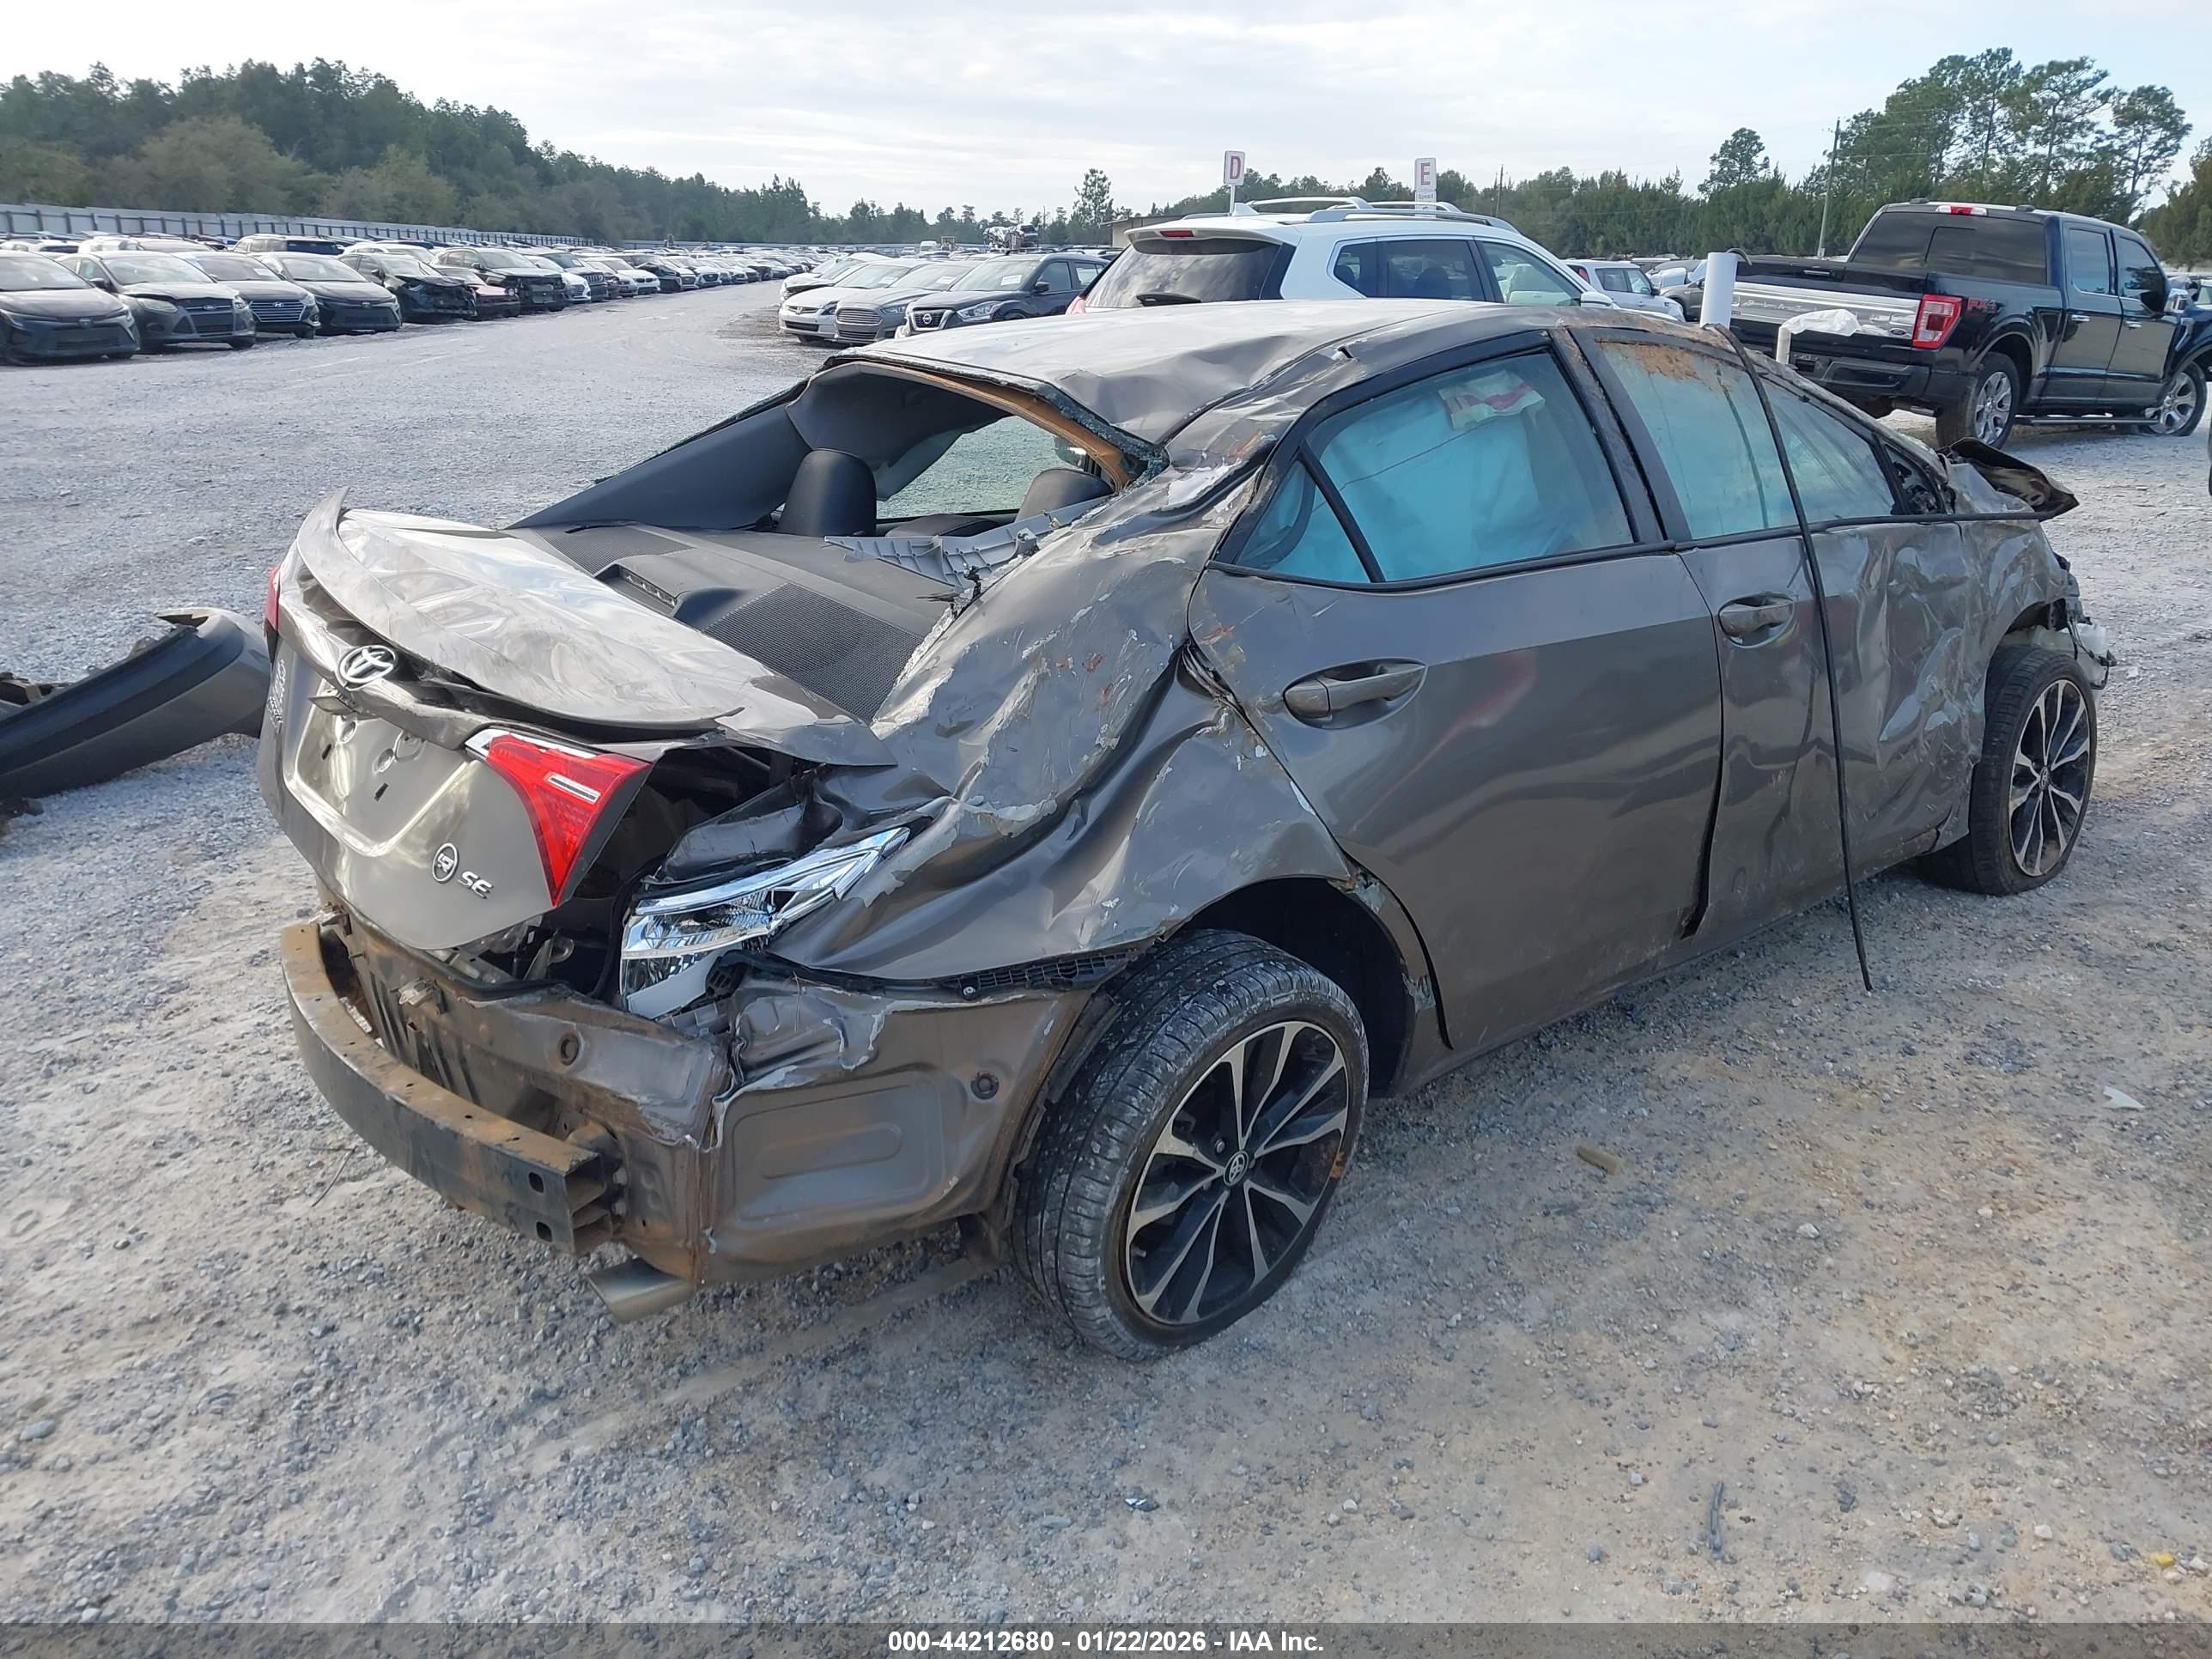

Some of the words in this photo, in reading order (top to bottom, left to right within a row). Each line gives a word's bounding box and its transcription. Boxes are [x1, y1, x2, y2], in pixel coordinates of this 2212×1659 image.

[1229, 155, 1242, 179] D
[1420, 162, 1431, 186] E
[458, 871, 494, 899] SE
